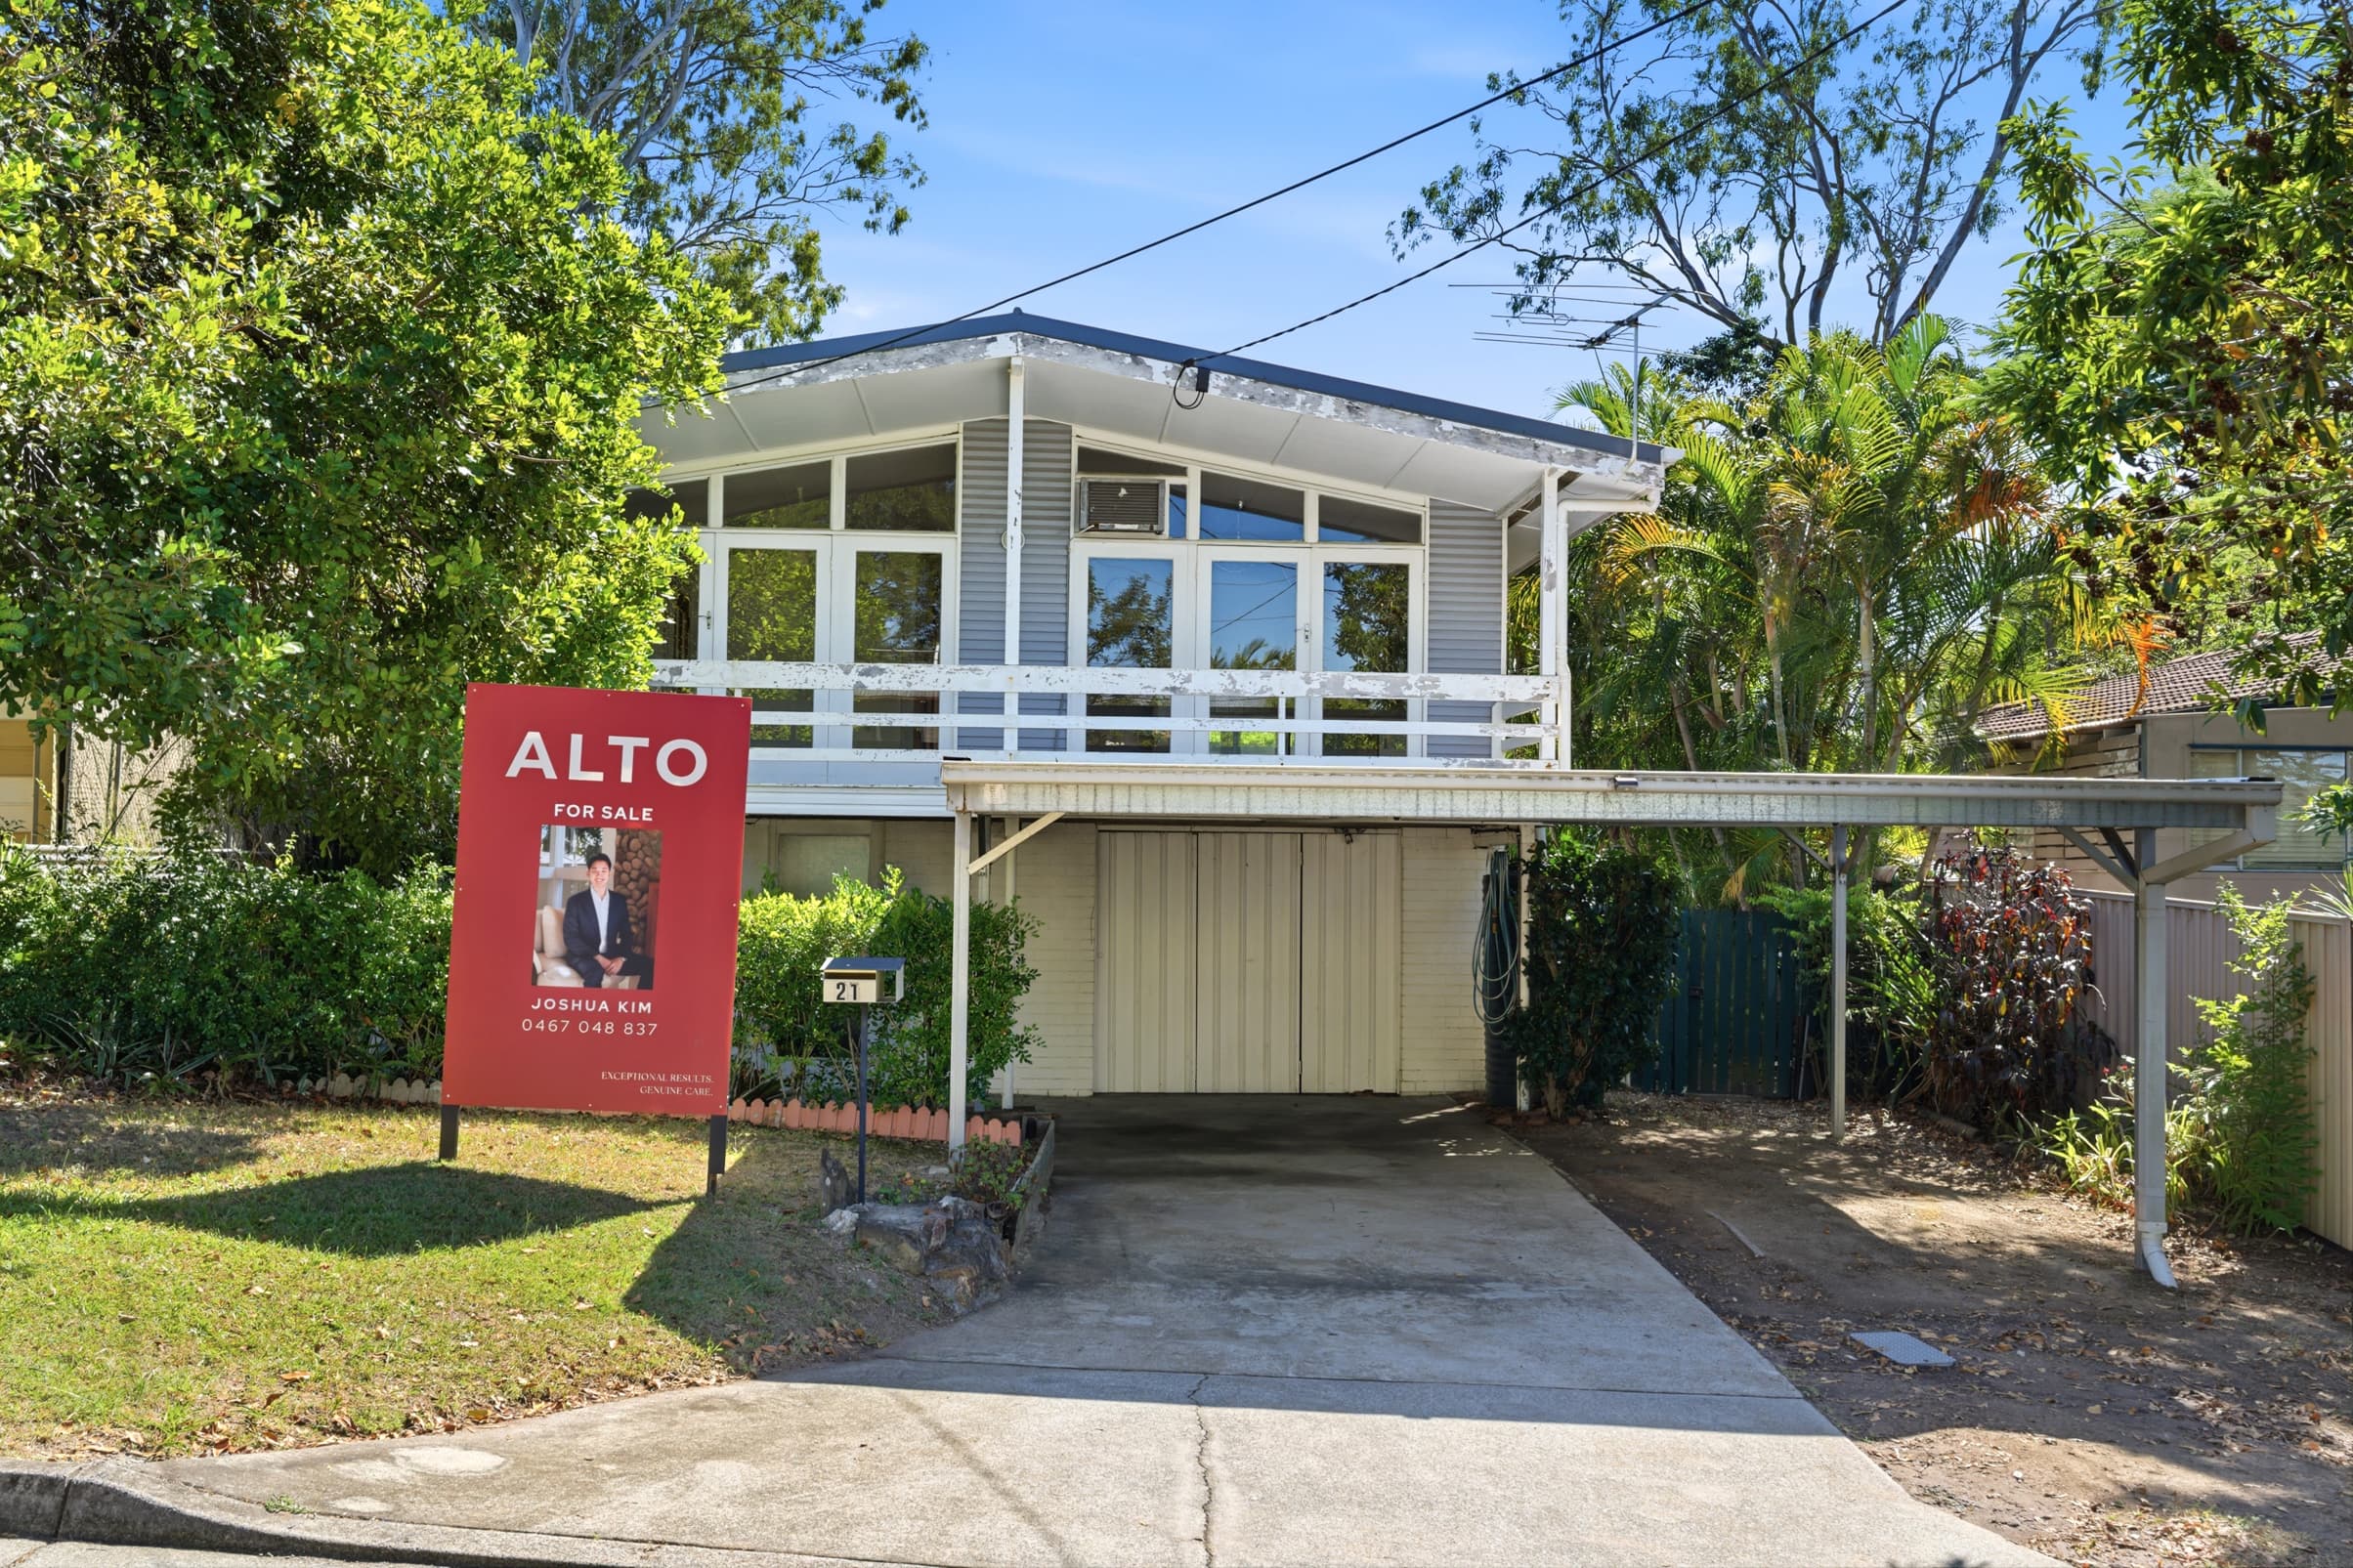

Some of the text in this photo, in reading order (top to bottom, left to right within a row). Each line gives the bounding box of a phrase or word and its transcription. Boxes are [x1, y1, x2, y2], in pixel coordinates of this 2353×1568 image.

[505, 731, 708, 787] ALTO
[554, 803, 654, 822] FOR SALE
[836, 982, 857, 1000] 21
[531, 997, 652, 1014] JOSHUA KIM
[522, 1018, 658, 1036] 0467 048 837
[601, 1071, 714, 1083] EXCEPTIONAL RESULTS.
[639, 1085, 714, 1097] GENUINE CARE.
